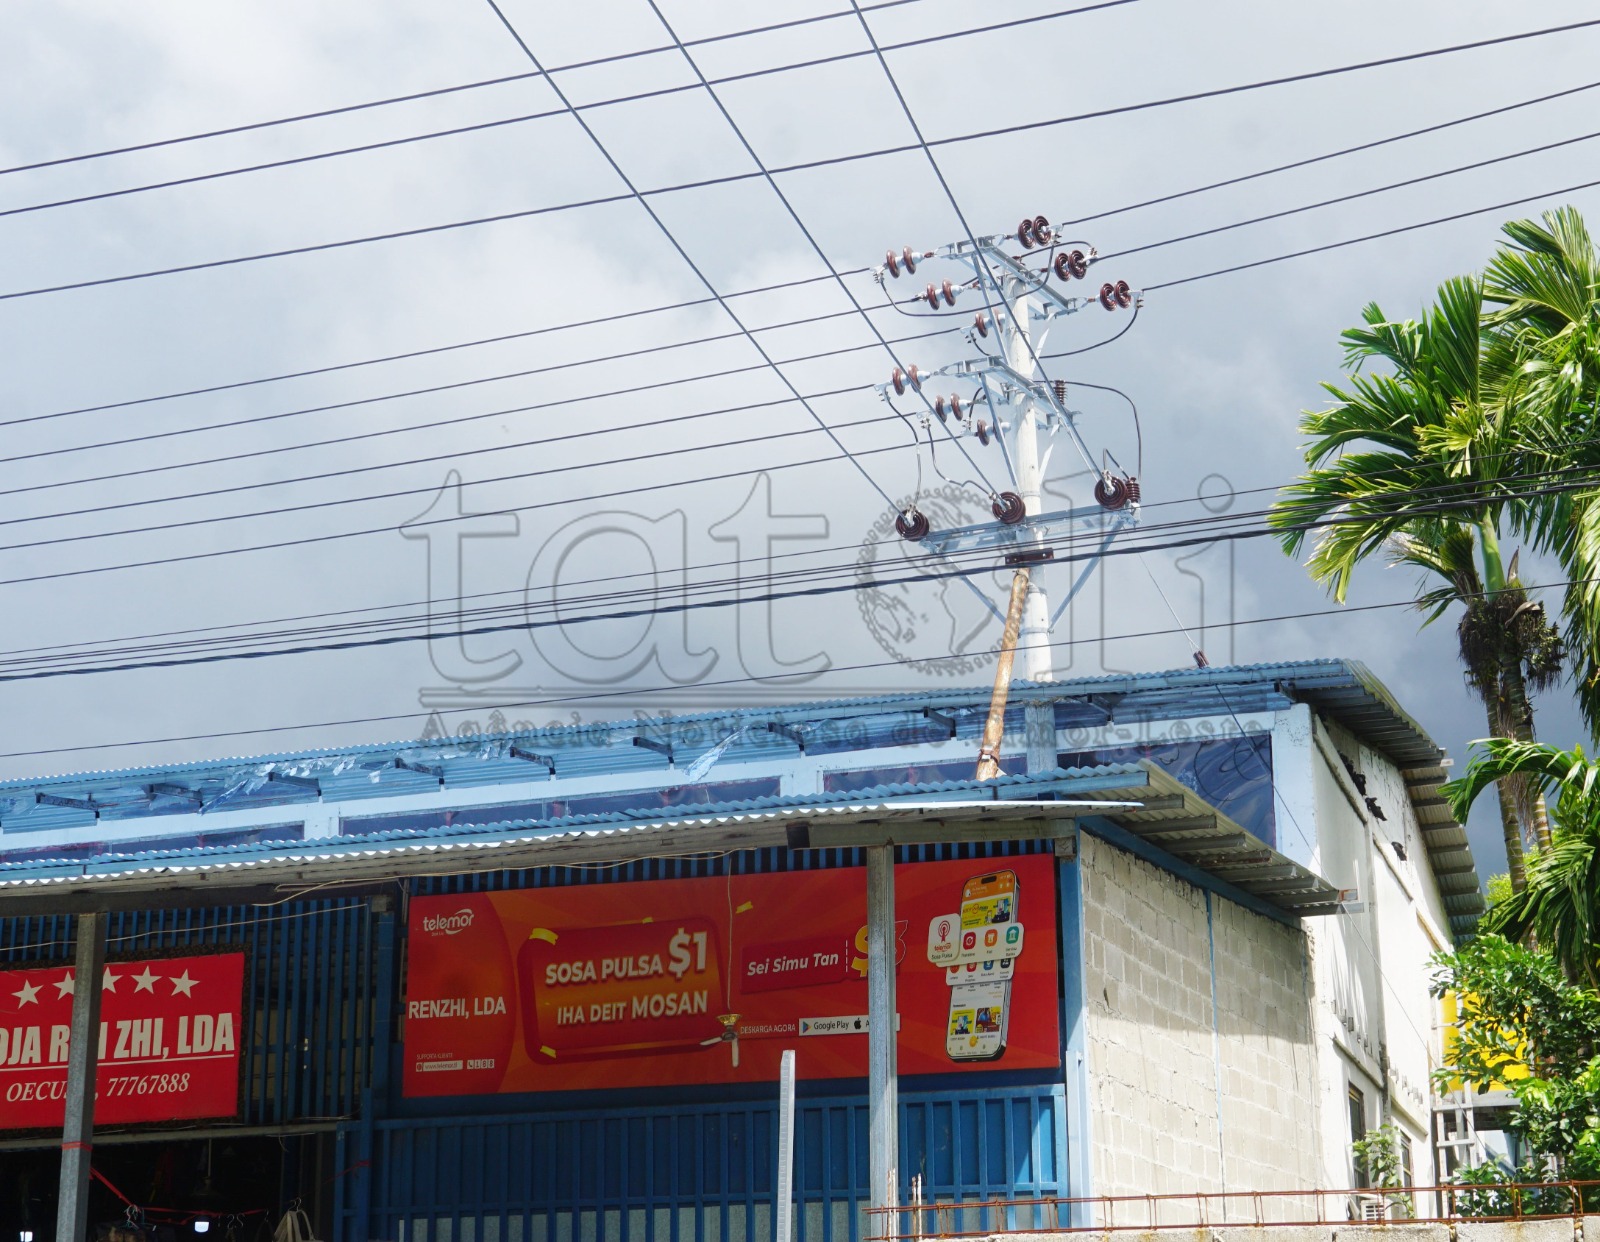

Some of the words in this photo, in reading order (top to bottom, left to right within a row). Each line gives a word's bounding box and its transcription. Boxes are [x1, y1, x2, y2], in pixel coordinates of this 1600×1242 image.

[422, 909, 475, 933] telemor
[545, 961, 597, 985] SOSA
[602, 954, 664, 979] PULSA
[668, 928, 708, 978] $1
[747, 961, 770, 976] Sei
[772, 957, 808, 973] Simu
[813, 952, 839, 968] Tan
[408, 998, 469, 1019] RENZHI,
[473, 996, 507, 1016] LDA
[556, 1004, 585, 1025] IHA
[590, 1002, 626, 1022] DEIT
[631, 990, 708, 1018] MOSAN
[114, 1018, 169, 1059] ZHI,
[177, 1012, 235, 1055] LDA
[740, 1025, 773, 1034] DESKARGA
[774, 1024, 796, 1033] AGORA
[813, 1021, 836, 1031] Google
[837, 1020, 849, 1030] Play
[106, 1072, 191, 1097] 77767888
